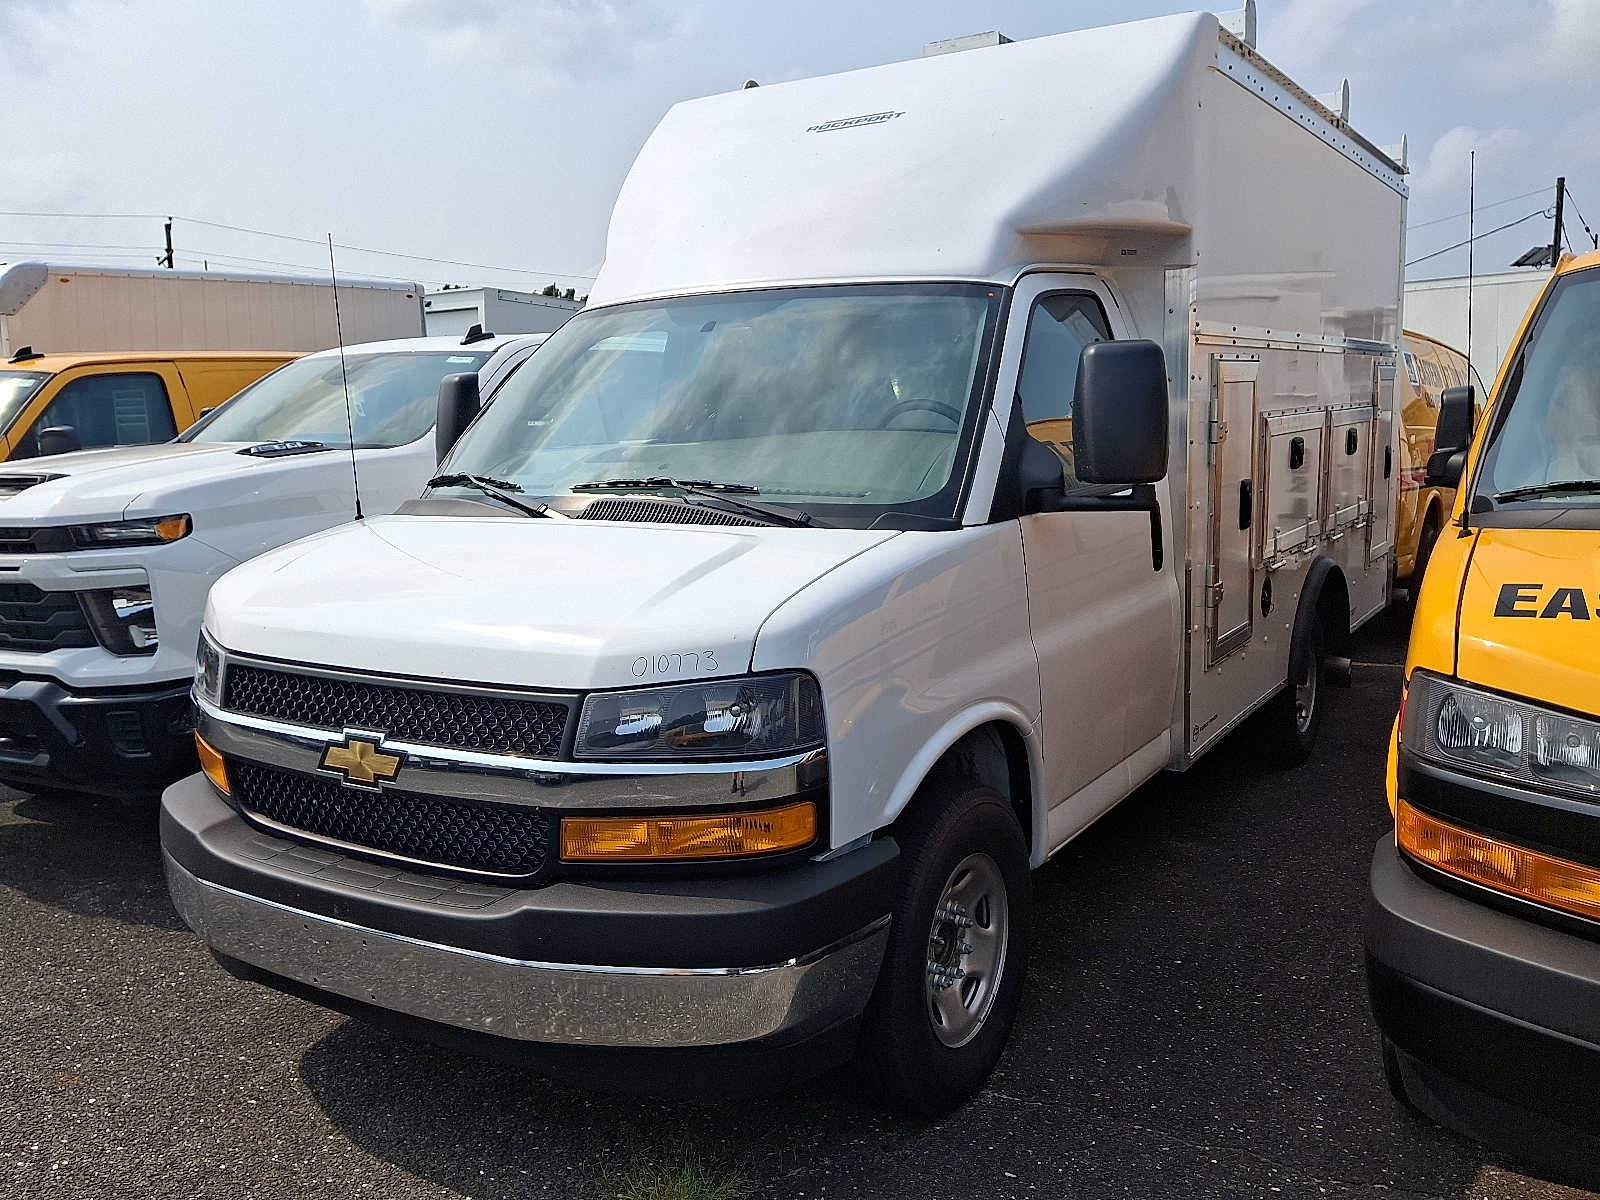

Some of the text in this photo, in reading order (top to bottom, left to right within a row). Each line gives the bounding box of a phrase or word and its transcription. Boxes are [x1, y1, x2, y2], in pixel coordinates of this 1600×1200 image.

[806, 111, 906, 133] ROCKPORT
[1493, 583, 1600, 620] EA
[632, 650, 719, 677] 010773
